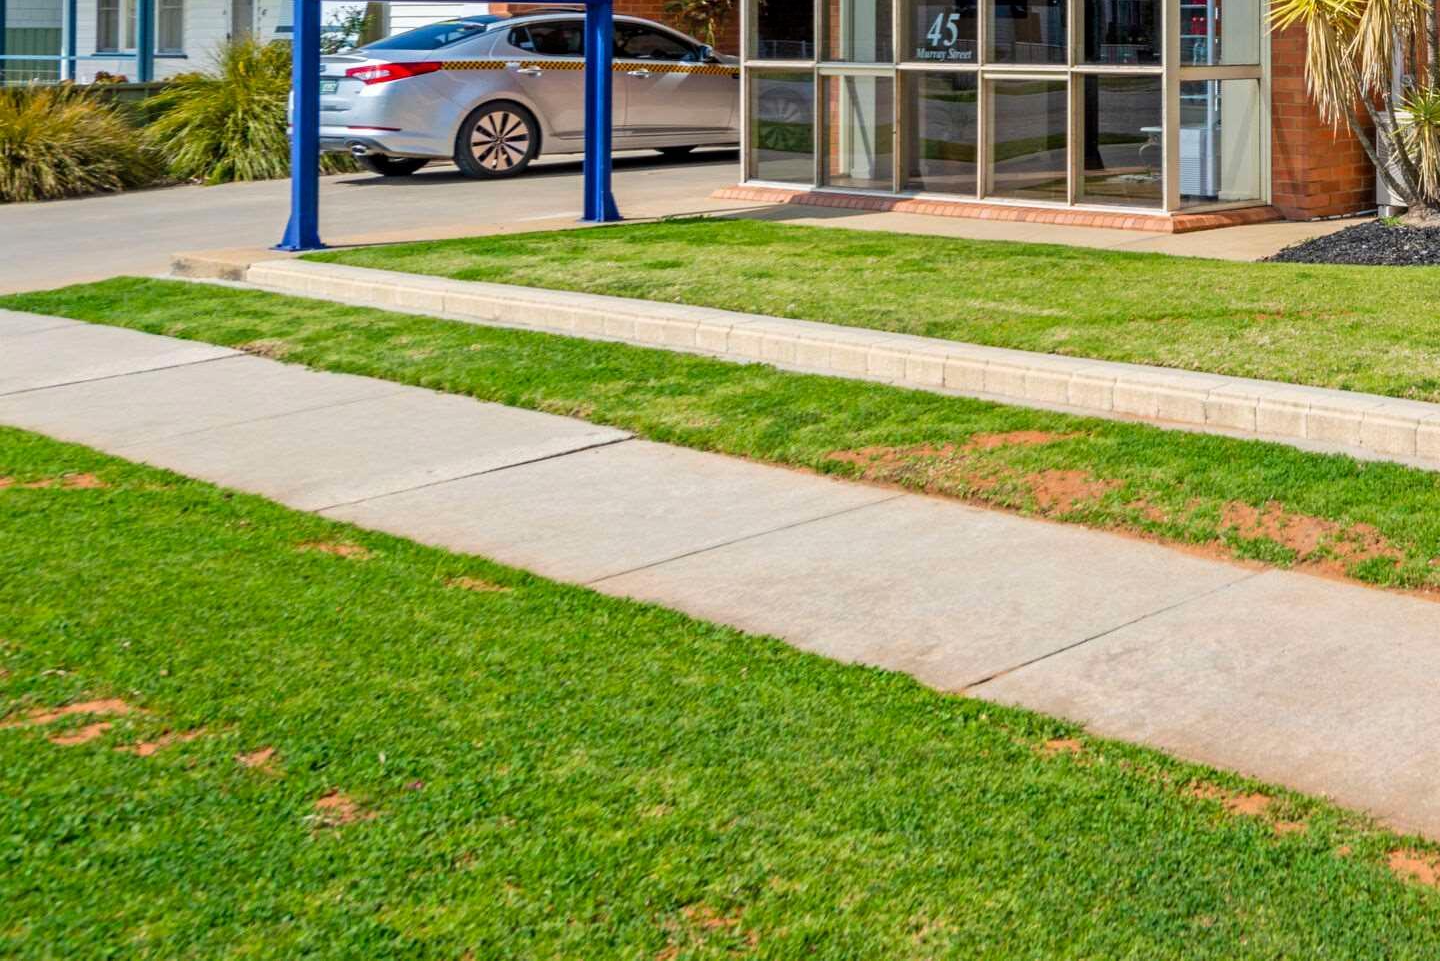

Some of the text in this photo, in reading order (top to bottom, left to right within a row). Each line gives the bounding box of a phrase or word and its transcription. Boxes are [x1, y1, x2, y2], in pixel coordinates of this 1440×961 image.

[926, 12, 961, 46] 45
[916, 48, 972, 61] Murray Street
